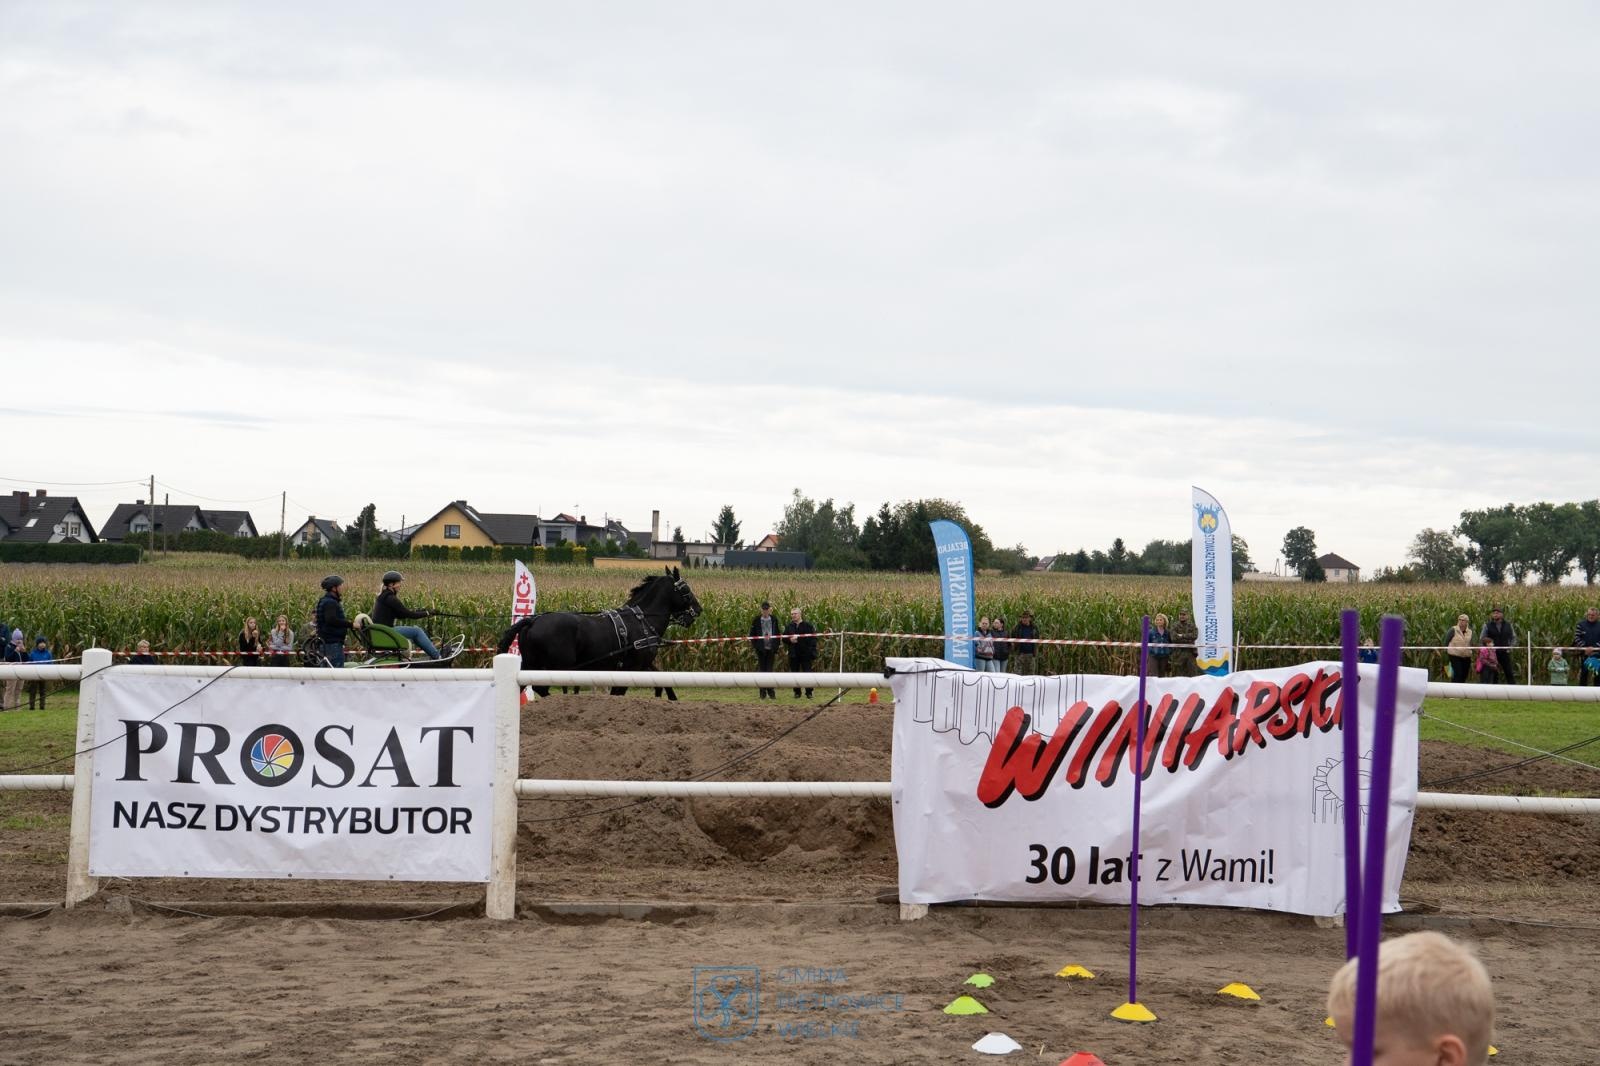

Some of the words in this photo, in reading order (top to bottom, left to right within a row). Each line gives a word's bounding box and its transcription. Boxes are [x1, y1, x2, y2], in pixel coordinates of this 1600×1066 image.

[115, 719, 474, 788] PROSAT
[113, 801, 207, 830] NASZ
[215, 804, 473, 834] DYSTRYBUTOR
[1025, 844, 1076, 885] 30
[1088, 846, 1143, 885] lat
[1156, 858, 1172, 882] z
[1181, 848, 1274, 884] Wami!
